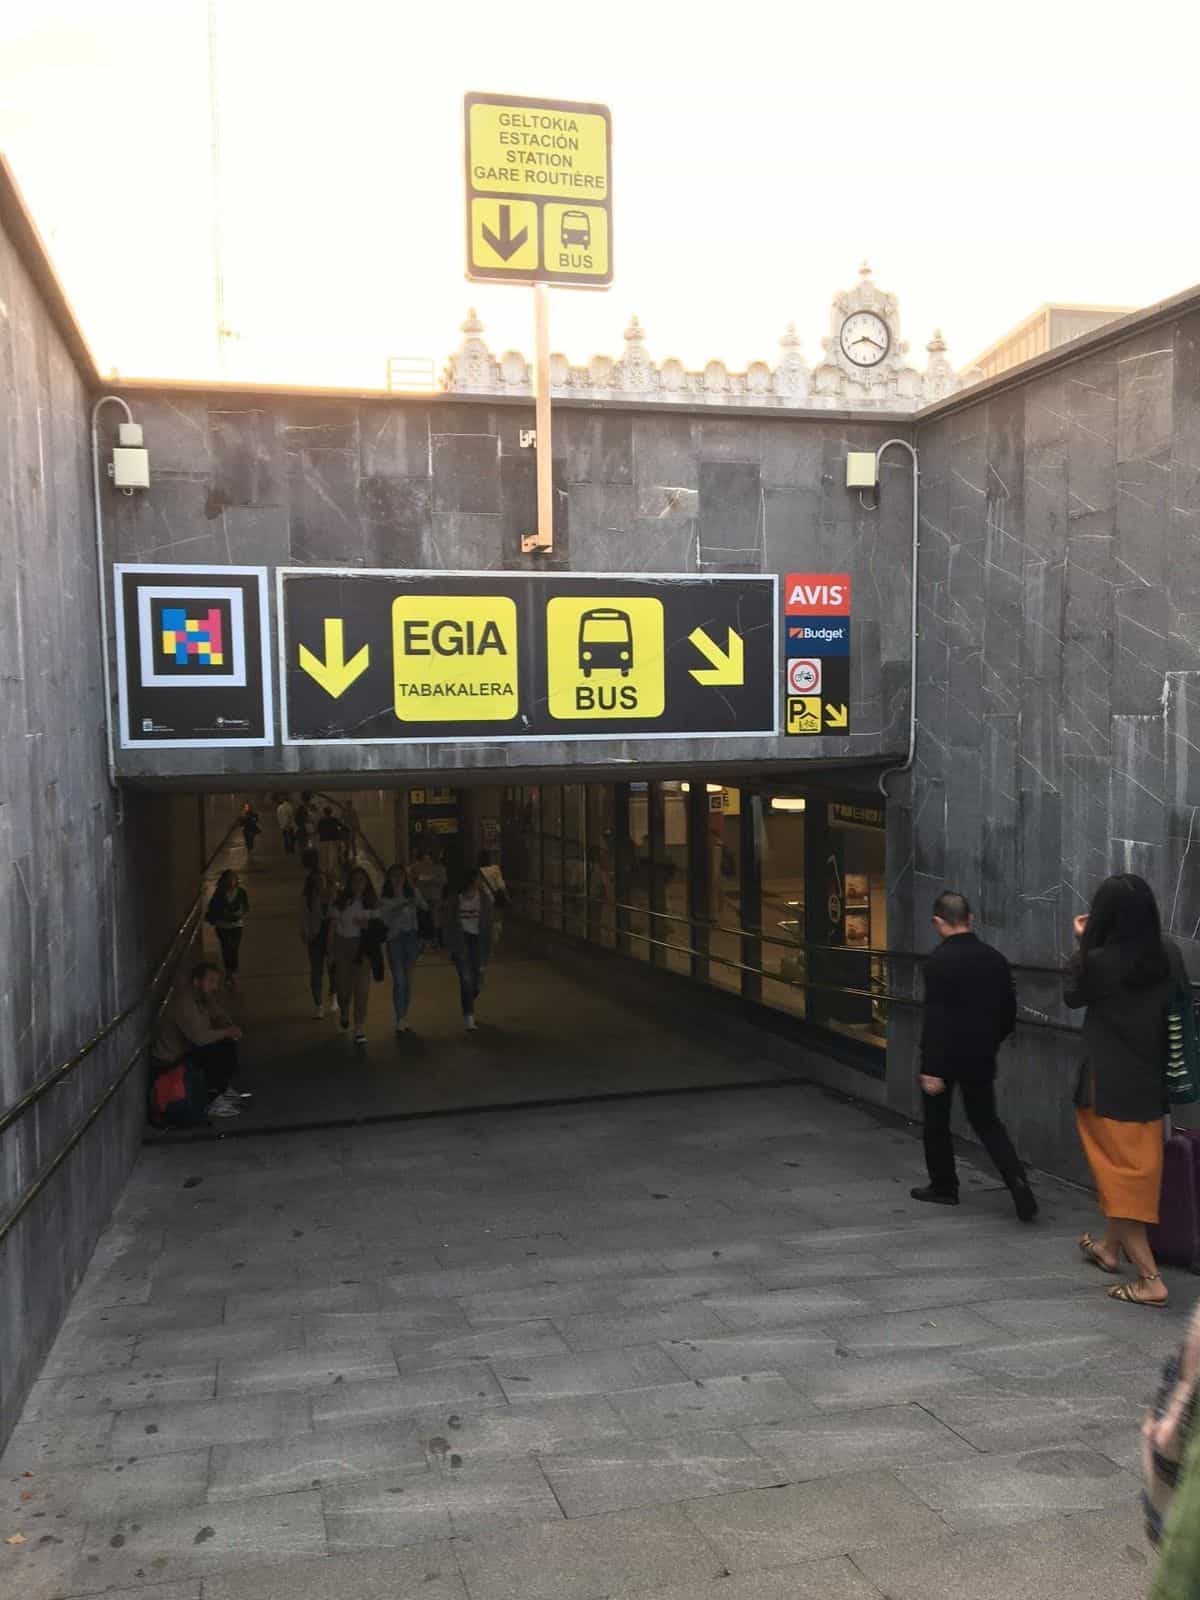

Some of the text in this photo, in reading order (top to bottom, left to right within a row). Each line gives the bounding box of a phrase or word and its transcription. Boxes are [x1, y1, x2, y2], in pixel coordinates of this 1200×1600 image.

[499, 113, 578, 132] GELTOKIA
[499, 132, 579, 151] ESTACIÓN
[506, 150, 573, 168] STATION
[474, 166, 605, 189] GARE ROUTIÈRE
[559, 253, 593, 269] BUS
[789, 585, 843, 606] AVIS
[403, 620, 507, 656] EGIA
[804, 627, 844, 641] Budget
[399, 683, 514, 697] TABAKALERA
[576, 686, 638, 710] BUS
[790, 699, 806, 723] P
